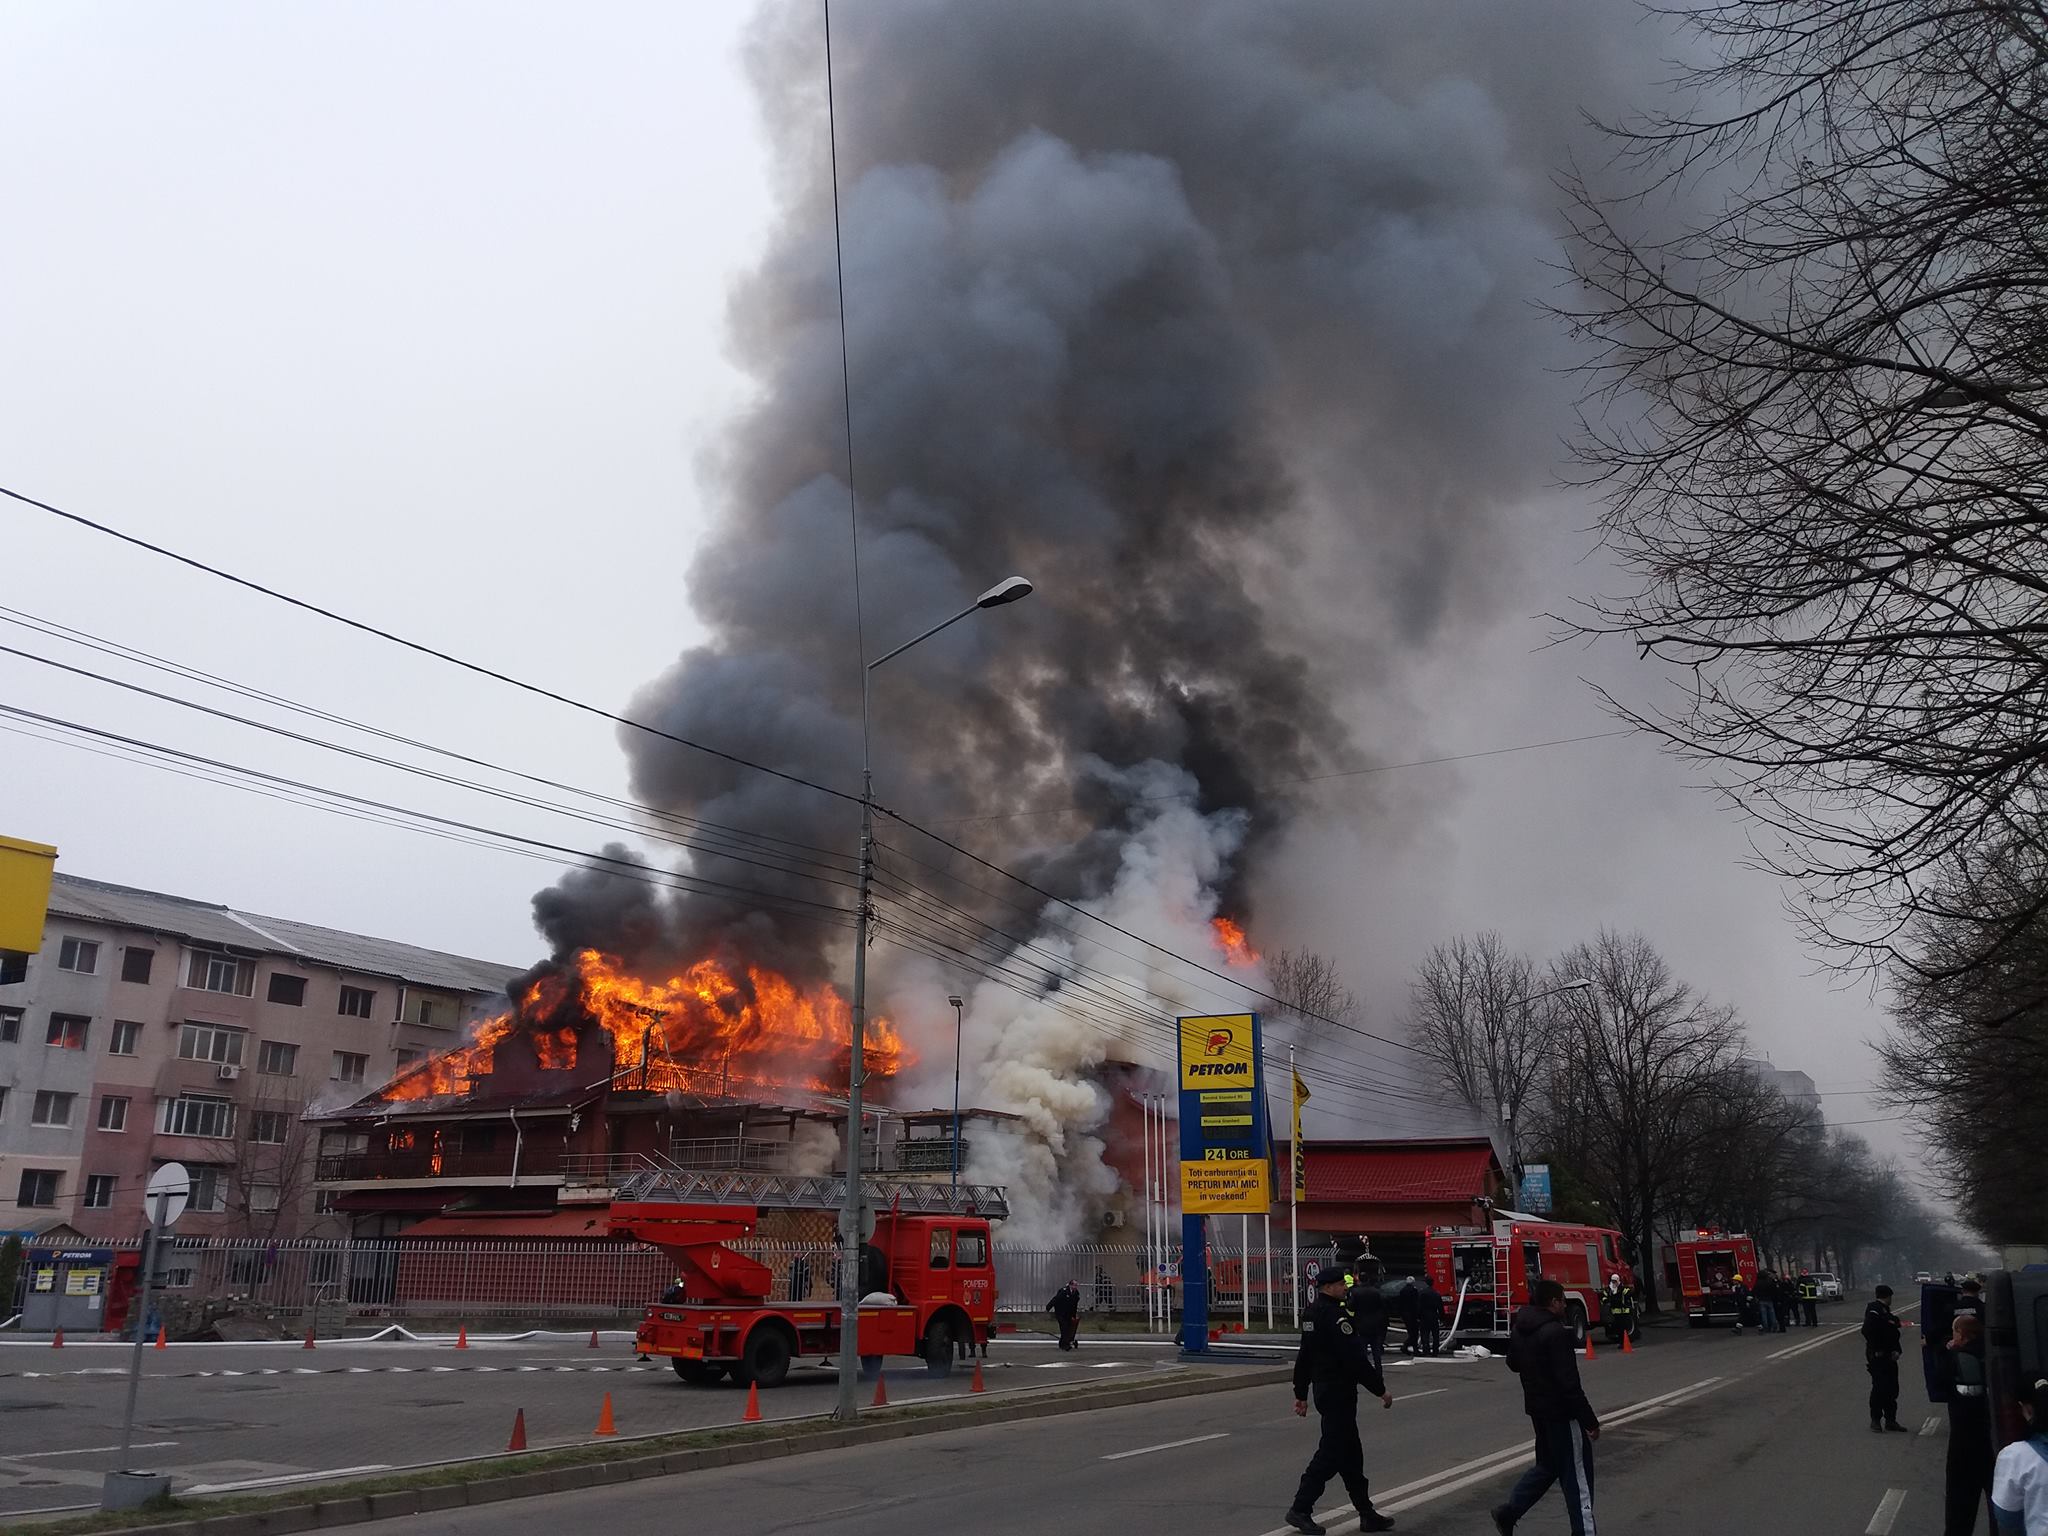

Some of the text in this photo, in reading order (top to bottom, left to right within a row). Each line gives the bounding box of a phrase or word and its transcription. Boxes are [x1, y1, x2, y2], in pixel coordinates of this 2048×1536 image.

[1189, 1062, 1248, 1076] PETROM
[1207, 1149, 1249, 1161] 24 ORE
[1248, 1169, 1258, 1177] au
[1222, 1180, 1239, 1189] MAI
[1241, 1179, 1259, 1189] MICI
